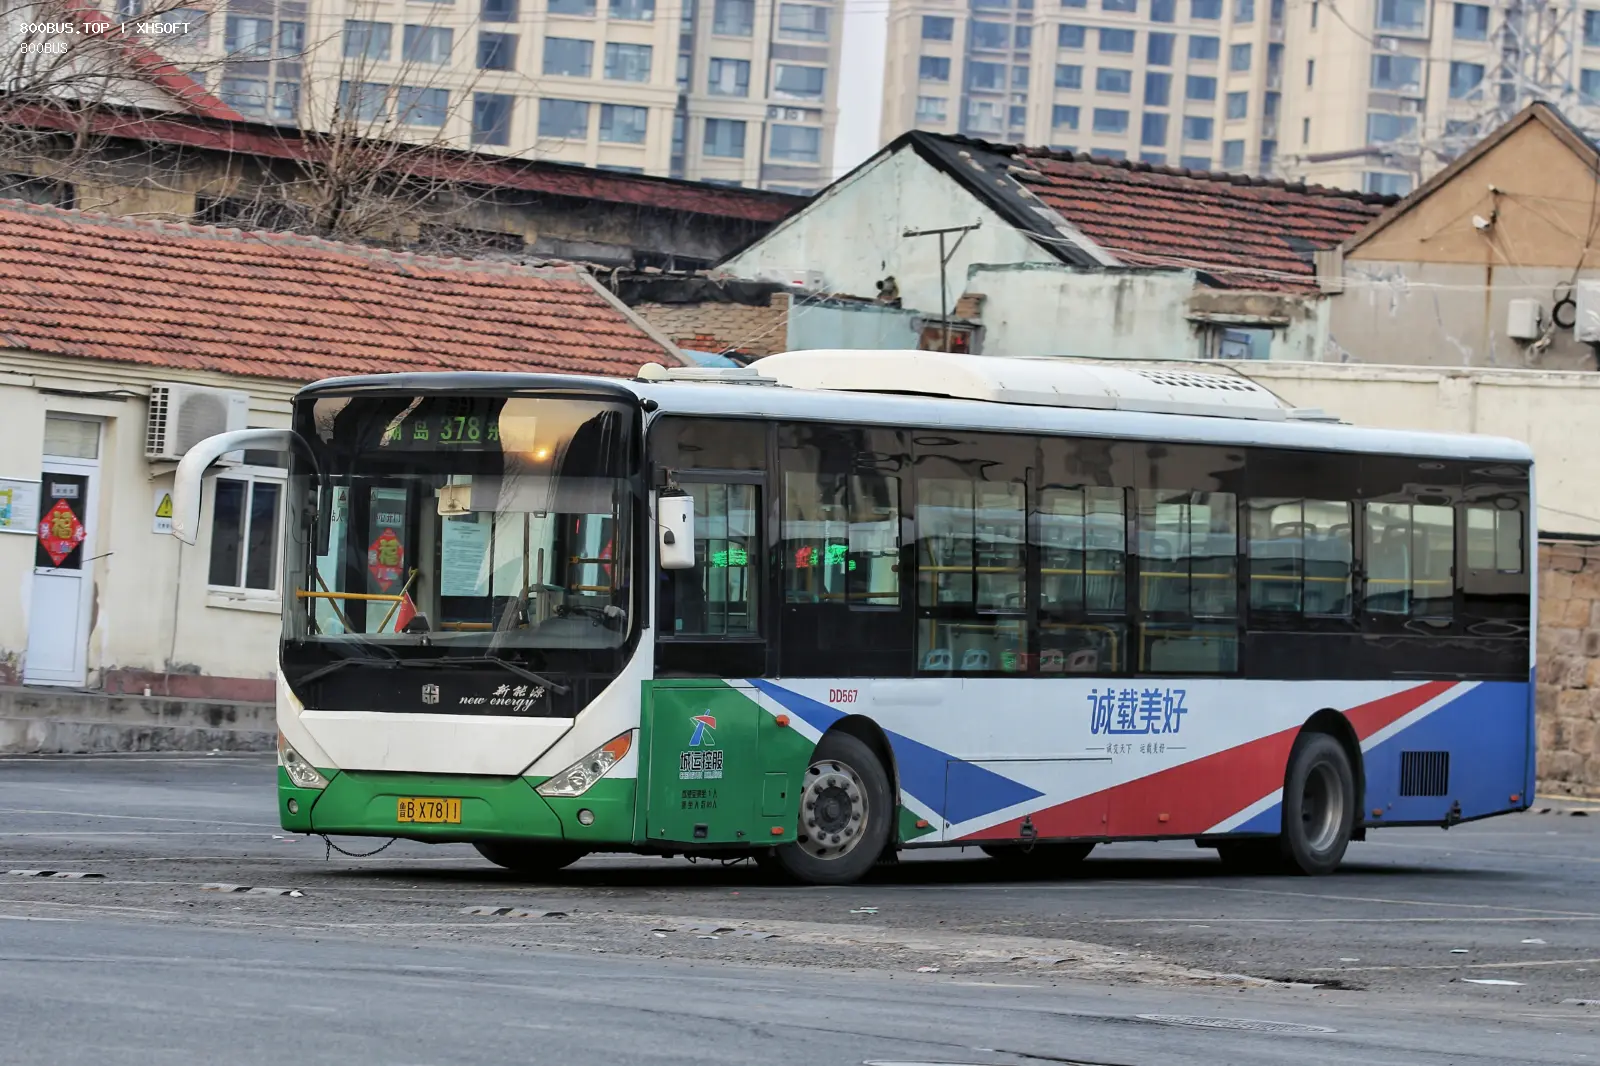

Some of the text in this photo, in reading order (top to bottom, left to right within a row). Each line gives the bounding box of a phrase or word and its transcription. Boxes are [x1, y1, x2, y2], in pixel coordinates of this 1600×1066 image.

[440, 417, 480, 440] 378
[492, 684, 545, 698] 新能源
[829, 688, 858, 703] DD567
[459, 696, 537, 712] new energy
[1087, 688, 1188, 735] 诚载美好
[680, 750, 724, 771] 城运控股
